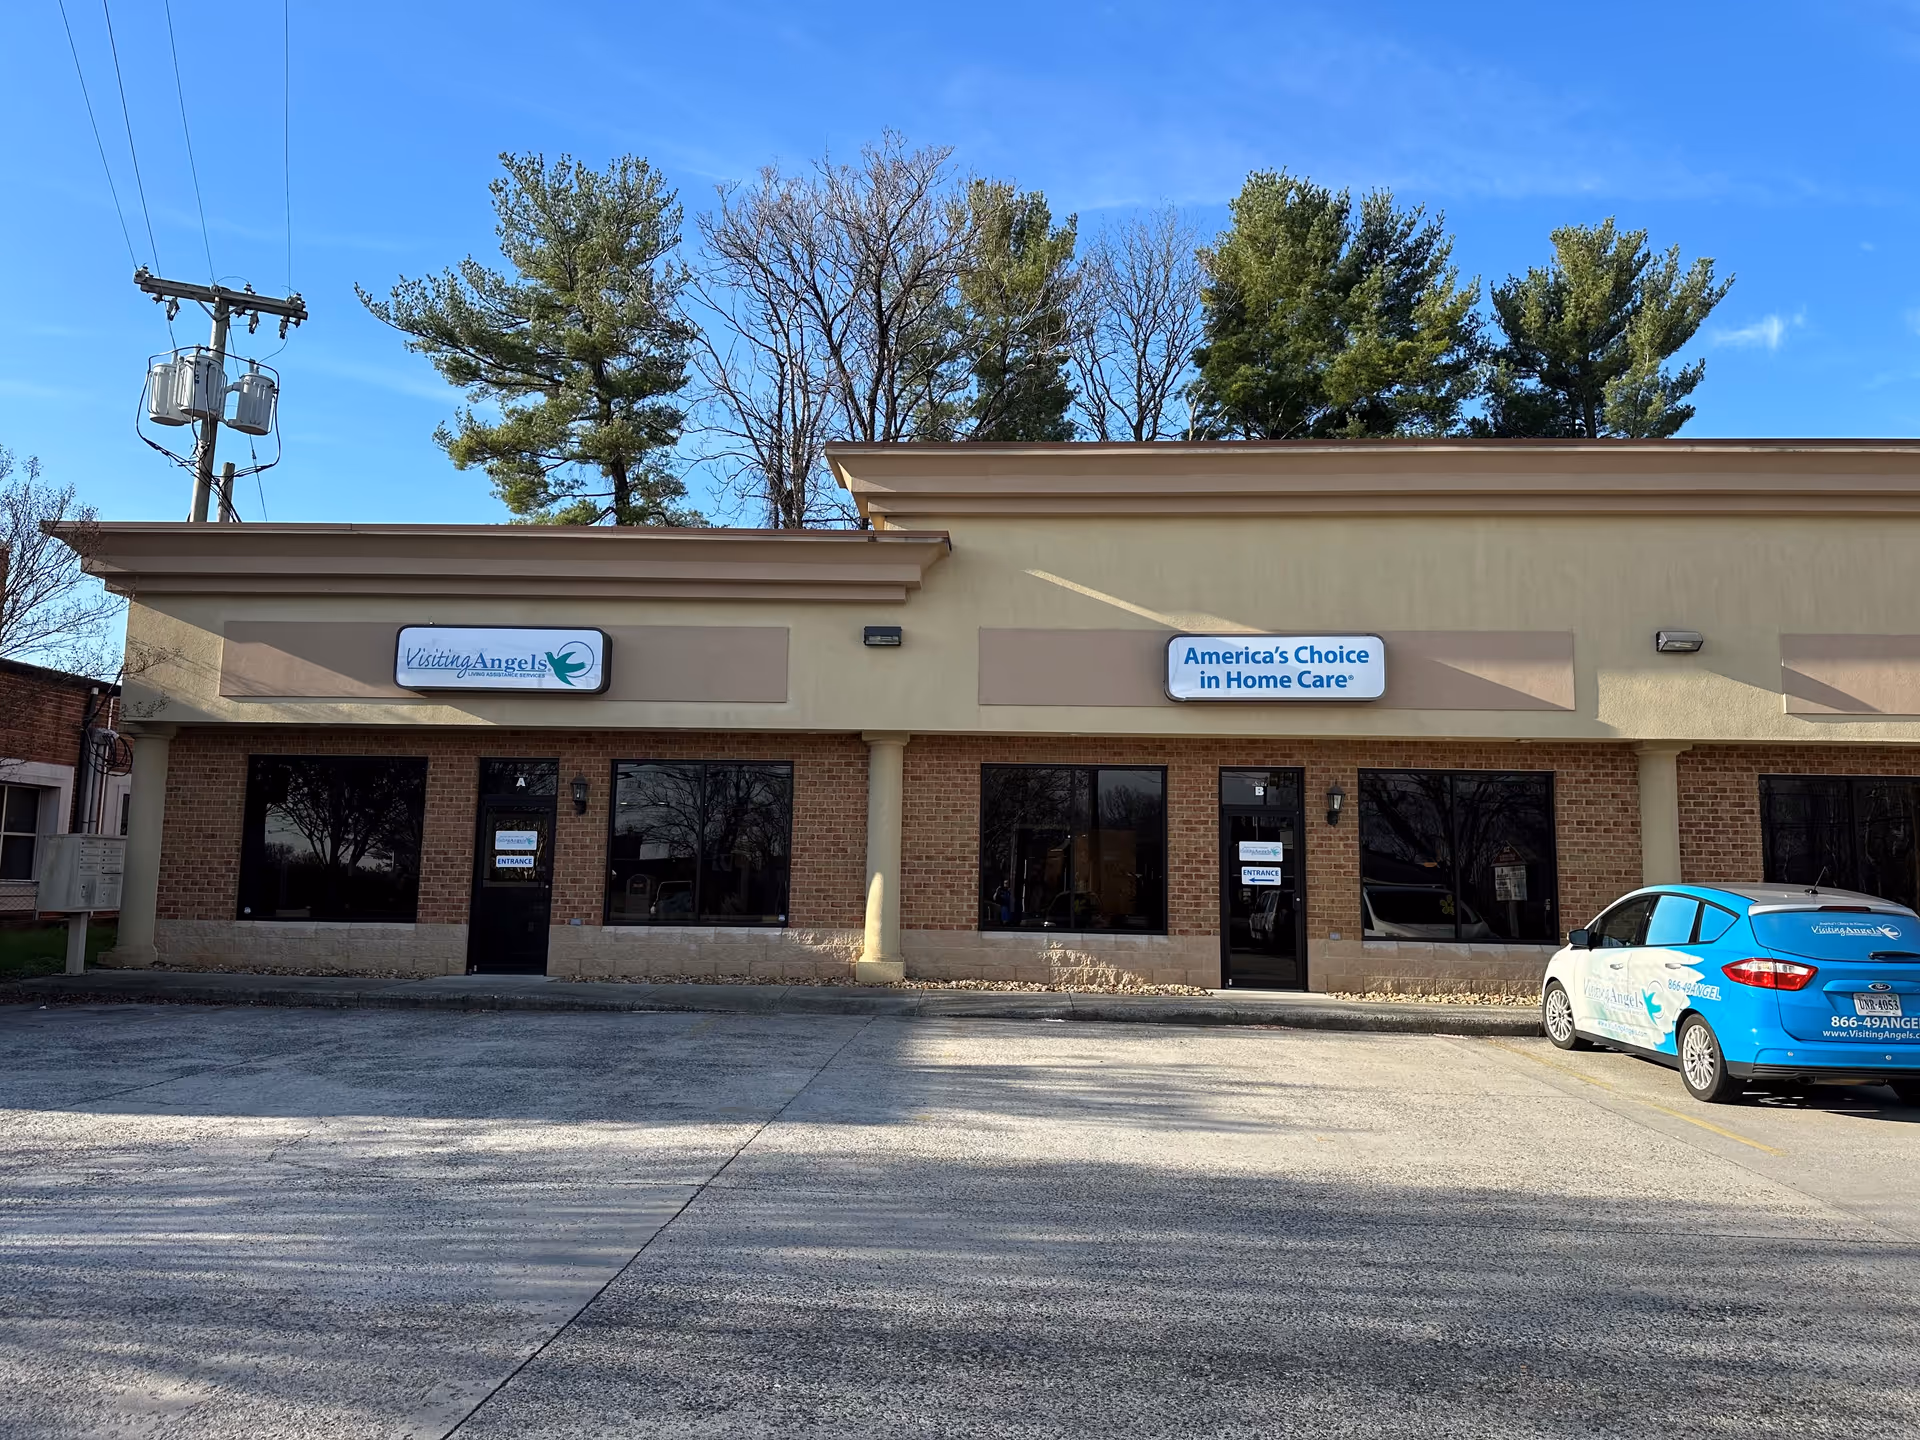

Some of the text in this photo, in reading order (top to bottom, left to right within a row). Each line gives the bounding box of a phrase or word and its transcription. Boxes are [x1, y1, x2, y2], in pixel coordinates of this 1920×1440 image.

[1184, 645, 1369, 665] America's Choice
[1200, 671, 1220, 689] in
[1226, 671, 1292, 689] Home
[516, 777, 525, 787] A
[1255, 786, 1264, 795] B
[1243, 869, 1280, 877] ENTRANCE
[1668, 978, 1722, 1001] 866-49ANGEL
[1831, 1015, 1920, 1029] 866-49ANGE
